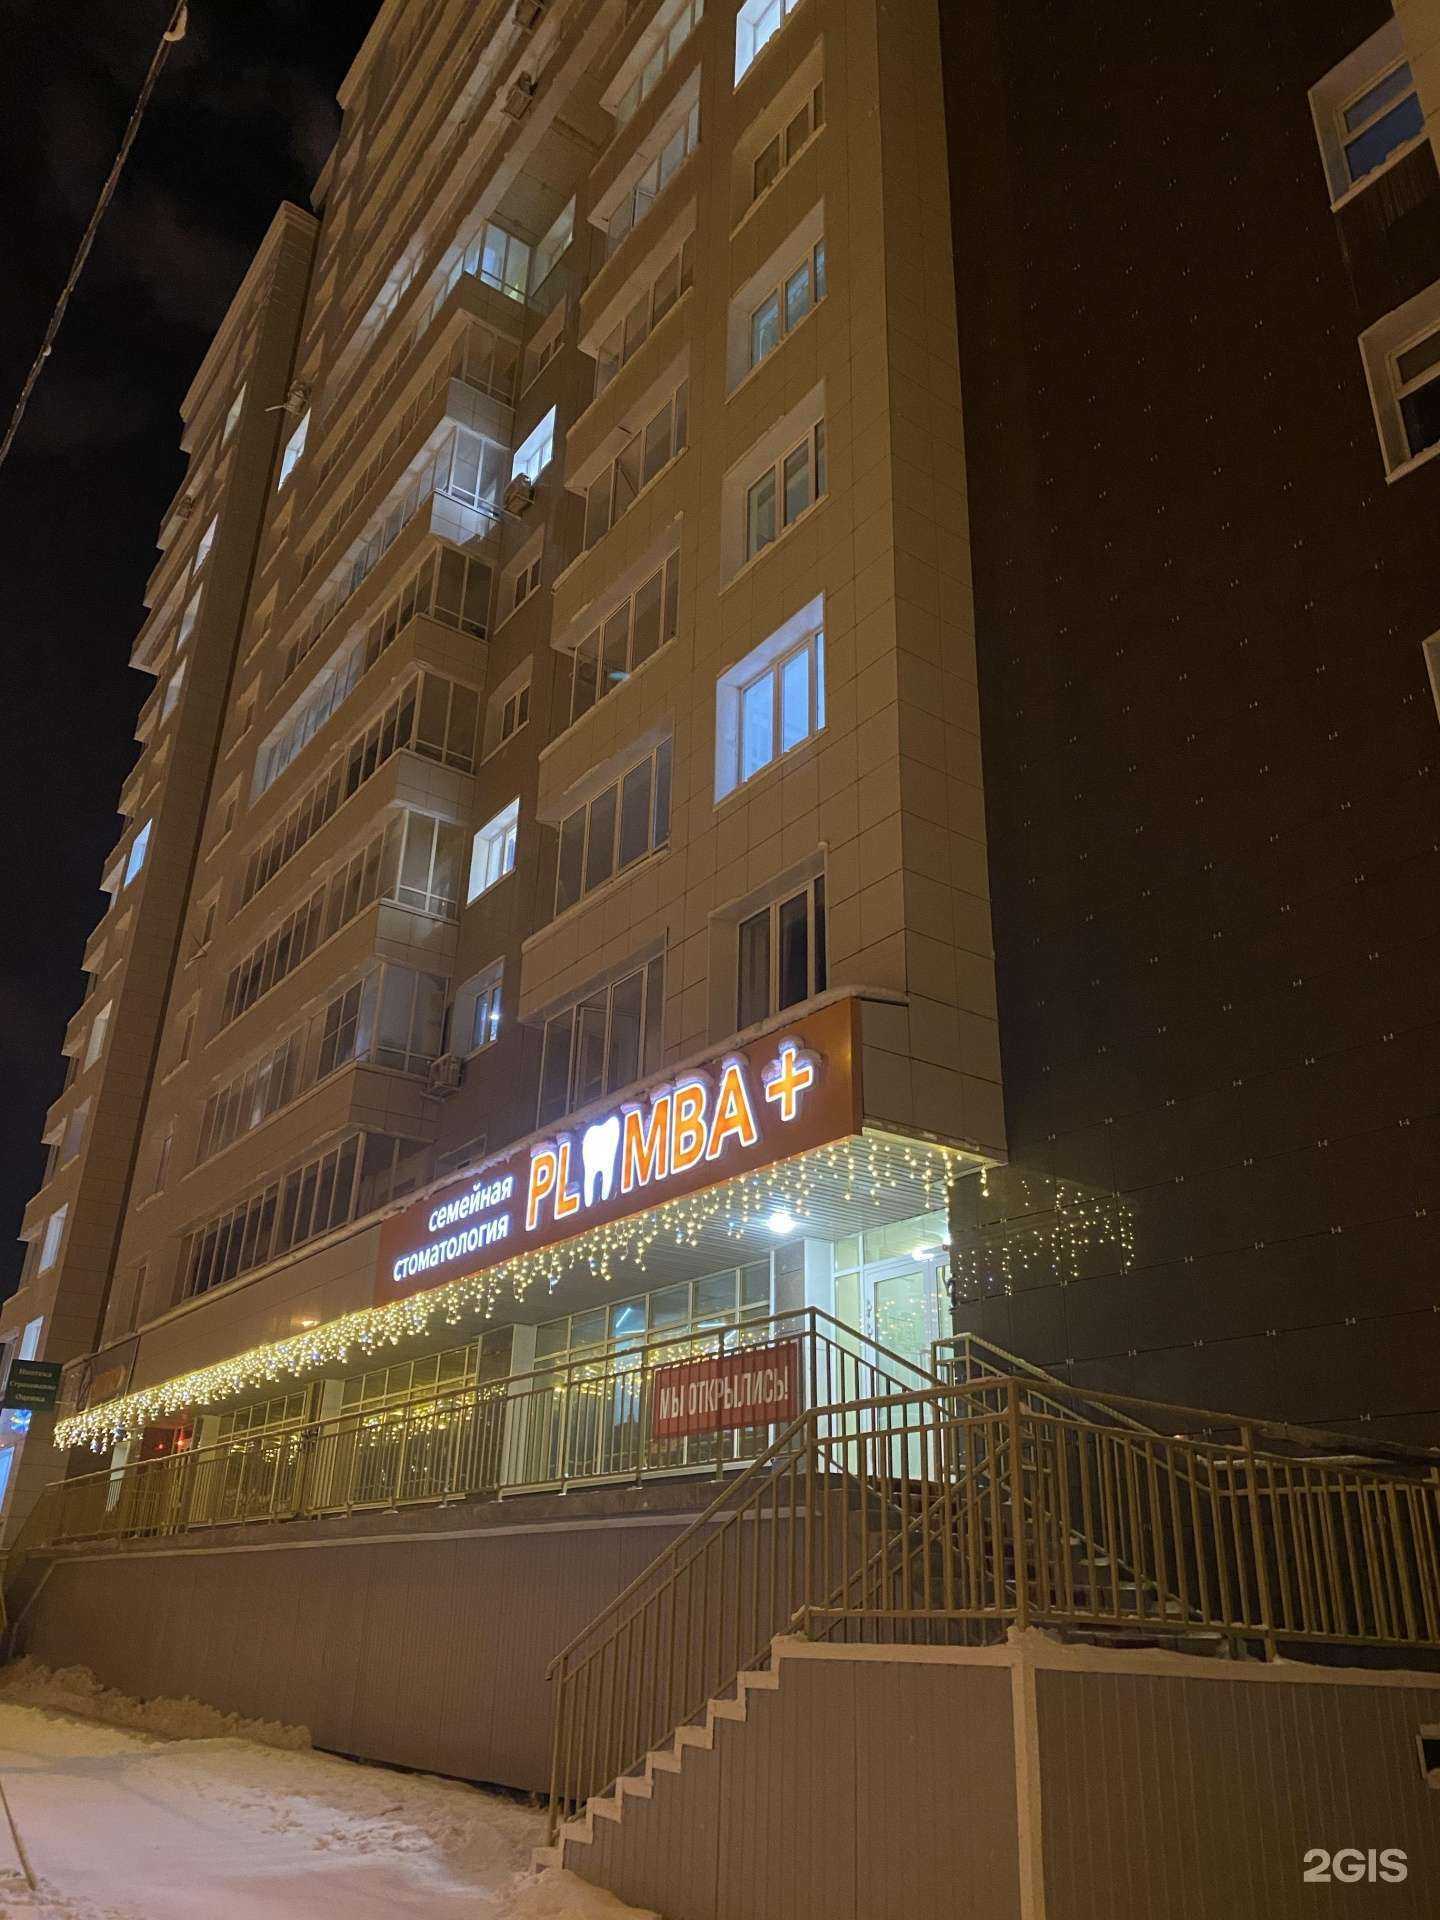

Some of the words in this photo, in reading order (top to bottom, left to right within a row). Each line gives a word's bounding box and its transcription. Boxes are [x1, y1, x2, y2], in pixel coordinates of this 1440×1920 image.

[428, 1176, 513, 1232] семейная
[393, 1214, 510, 1282] стоматология
[659, 1387, 685, 1420] МЫ
[688, 1365, 789, 1416] ОТКРЫЛИСЬ!
